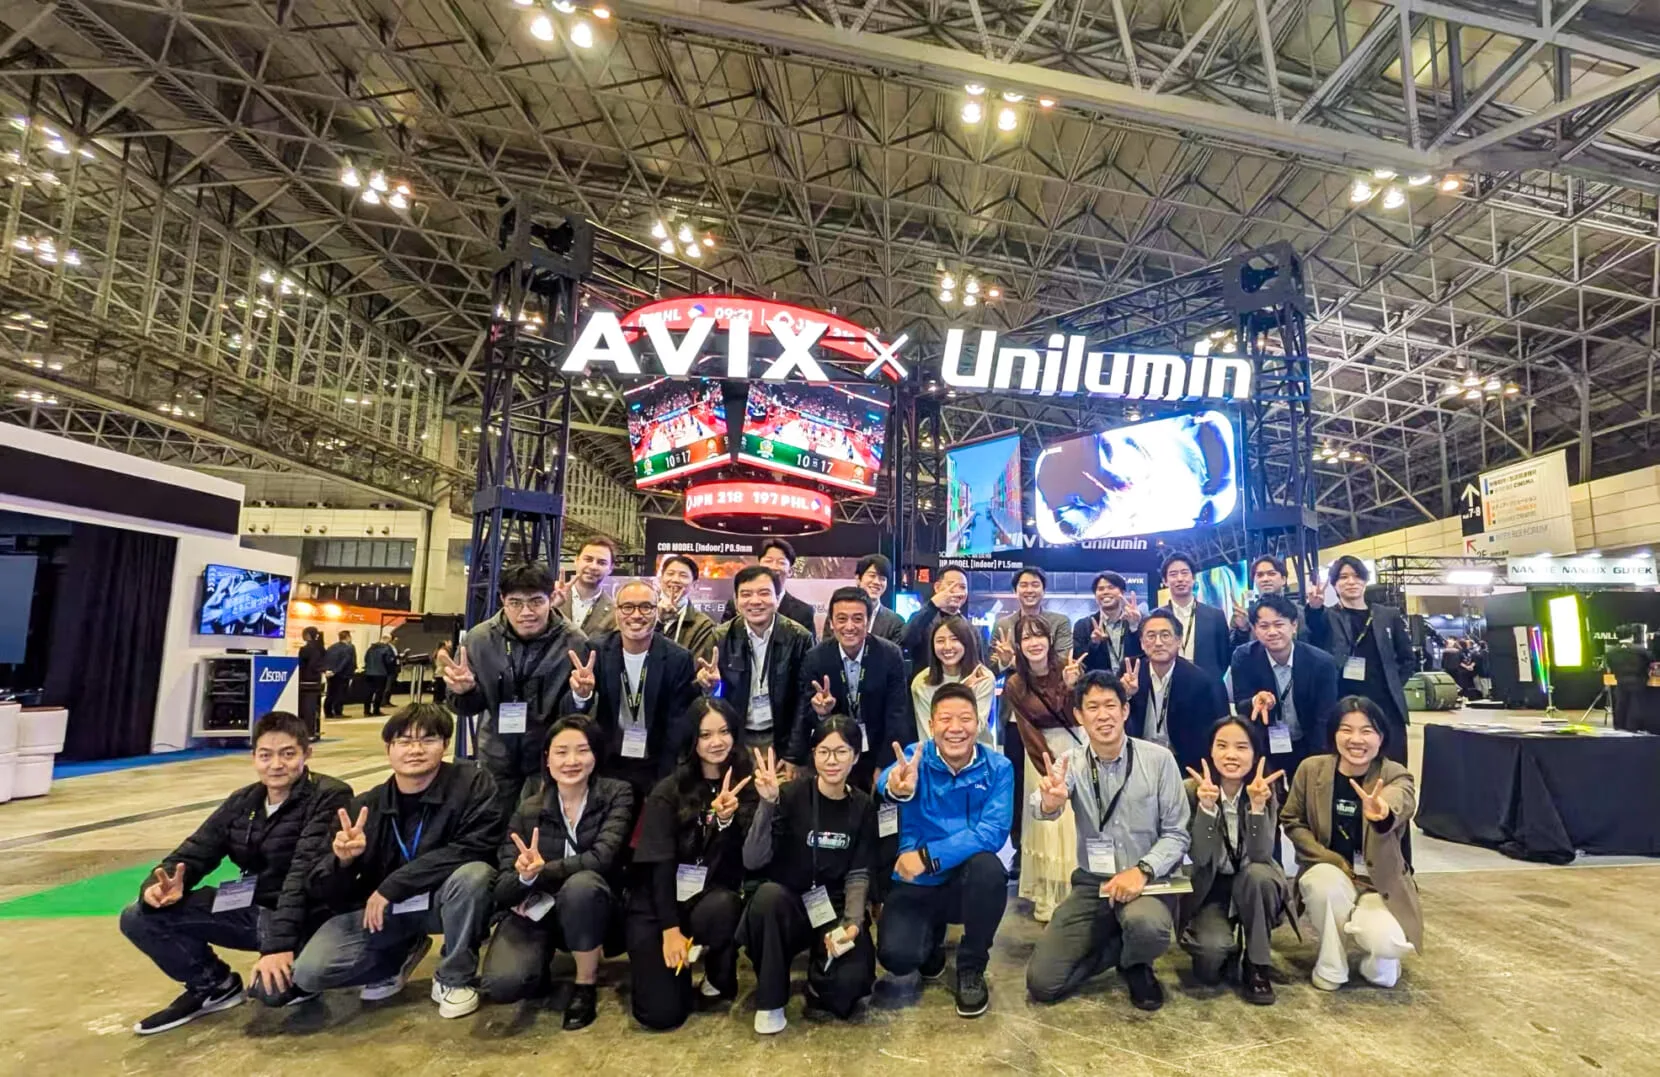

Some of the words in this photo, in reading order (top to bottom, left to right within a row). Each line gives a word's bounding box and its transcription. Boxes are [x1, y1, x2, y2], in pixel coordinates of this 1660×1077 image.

[561, 312, 829, 381] AVIX
[942, 329, 1251, 398] Unilumin
[665, 456, 675, 469] 10
[681, 450, 691, 463] 17
[796, 453, 810, 467] 10
[821, 460, 834, 474] 17
[717, 491, 744, 503] 218
[753, 491, 778, 505] 197
[781, 494, 809, 510] PHL
[672, 542, 694, 551] MODEL
[258, 667, 288, 682] ASCENT
